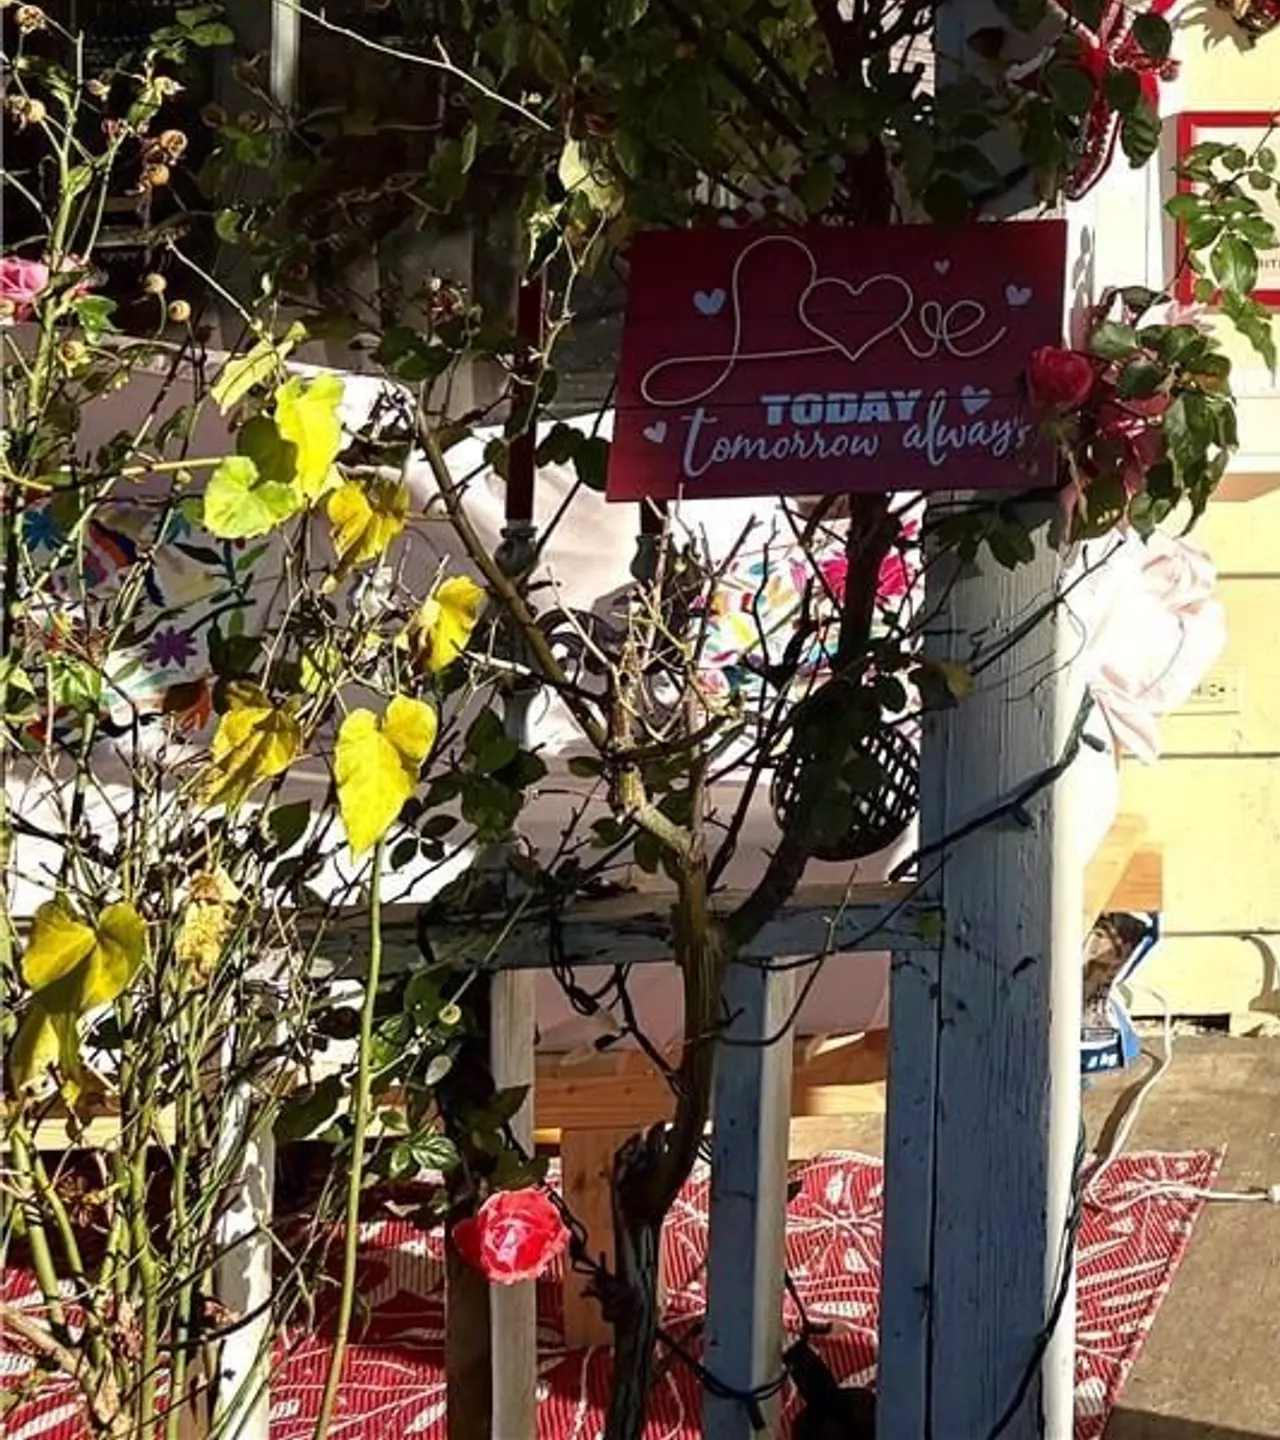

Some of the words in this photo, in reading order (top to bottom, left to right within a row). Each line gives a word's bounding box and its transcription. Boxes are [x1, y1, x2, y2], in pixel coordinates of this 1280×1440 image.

[640, 235, 1007, 406] Love
[681, 408, 880, 477] tomorrow
[902, 388, 1031, 467] always
[761, 389, 922, 426] TODAY
